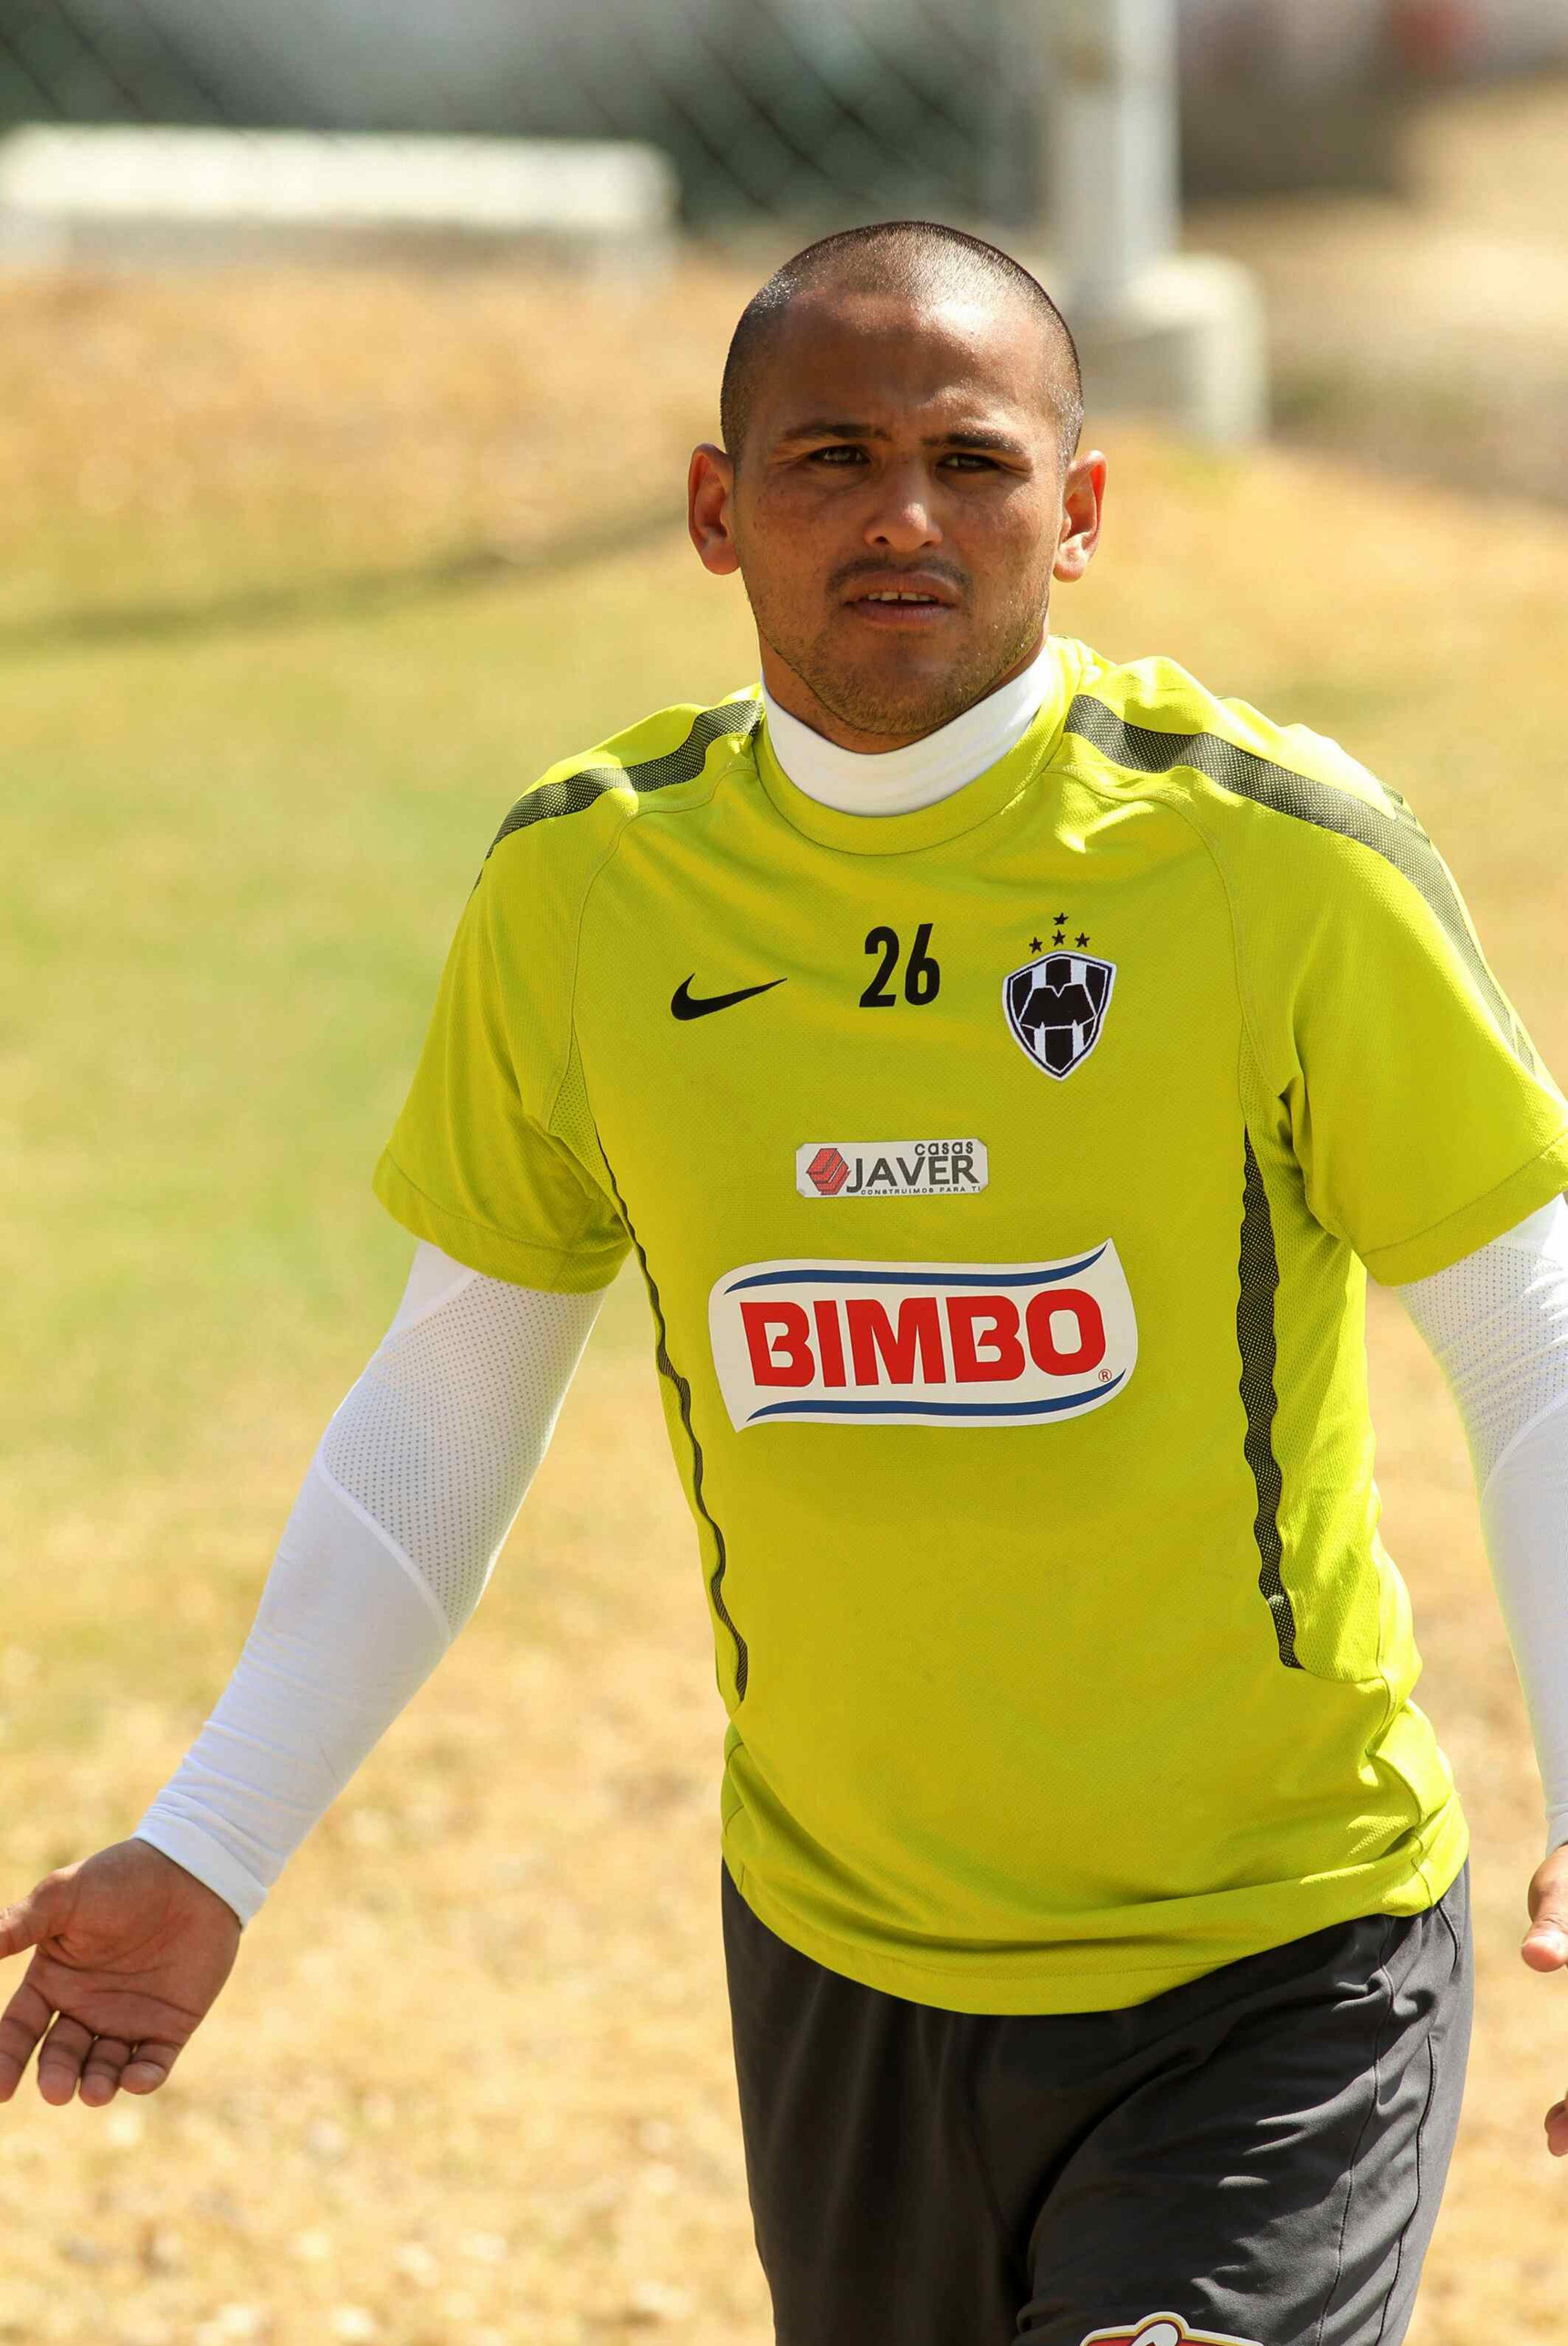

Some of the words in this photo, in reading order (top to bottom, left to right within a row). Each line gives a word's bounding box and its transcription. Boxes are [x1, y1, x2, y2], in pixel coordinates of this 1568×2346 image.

[859, 923, 940, 1008] 26
[914, 1142, 974, 1155] casas
[845, 1154, 980, 1193] JAVER
[860, 1187, 935, 1195] CONSTRUIMOS
[740, 1288, 1107, 1388] BIMBO
